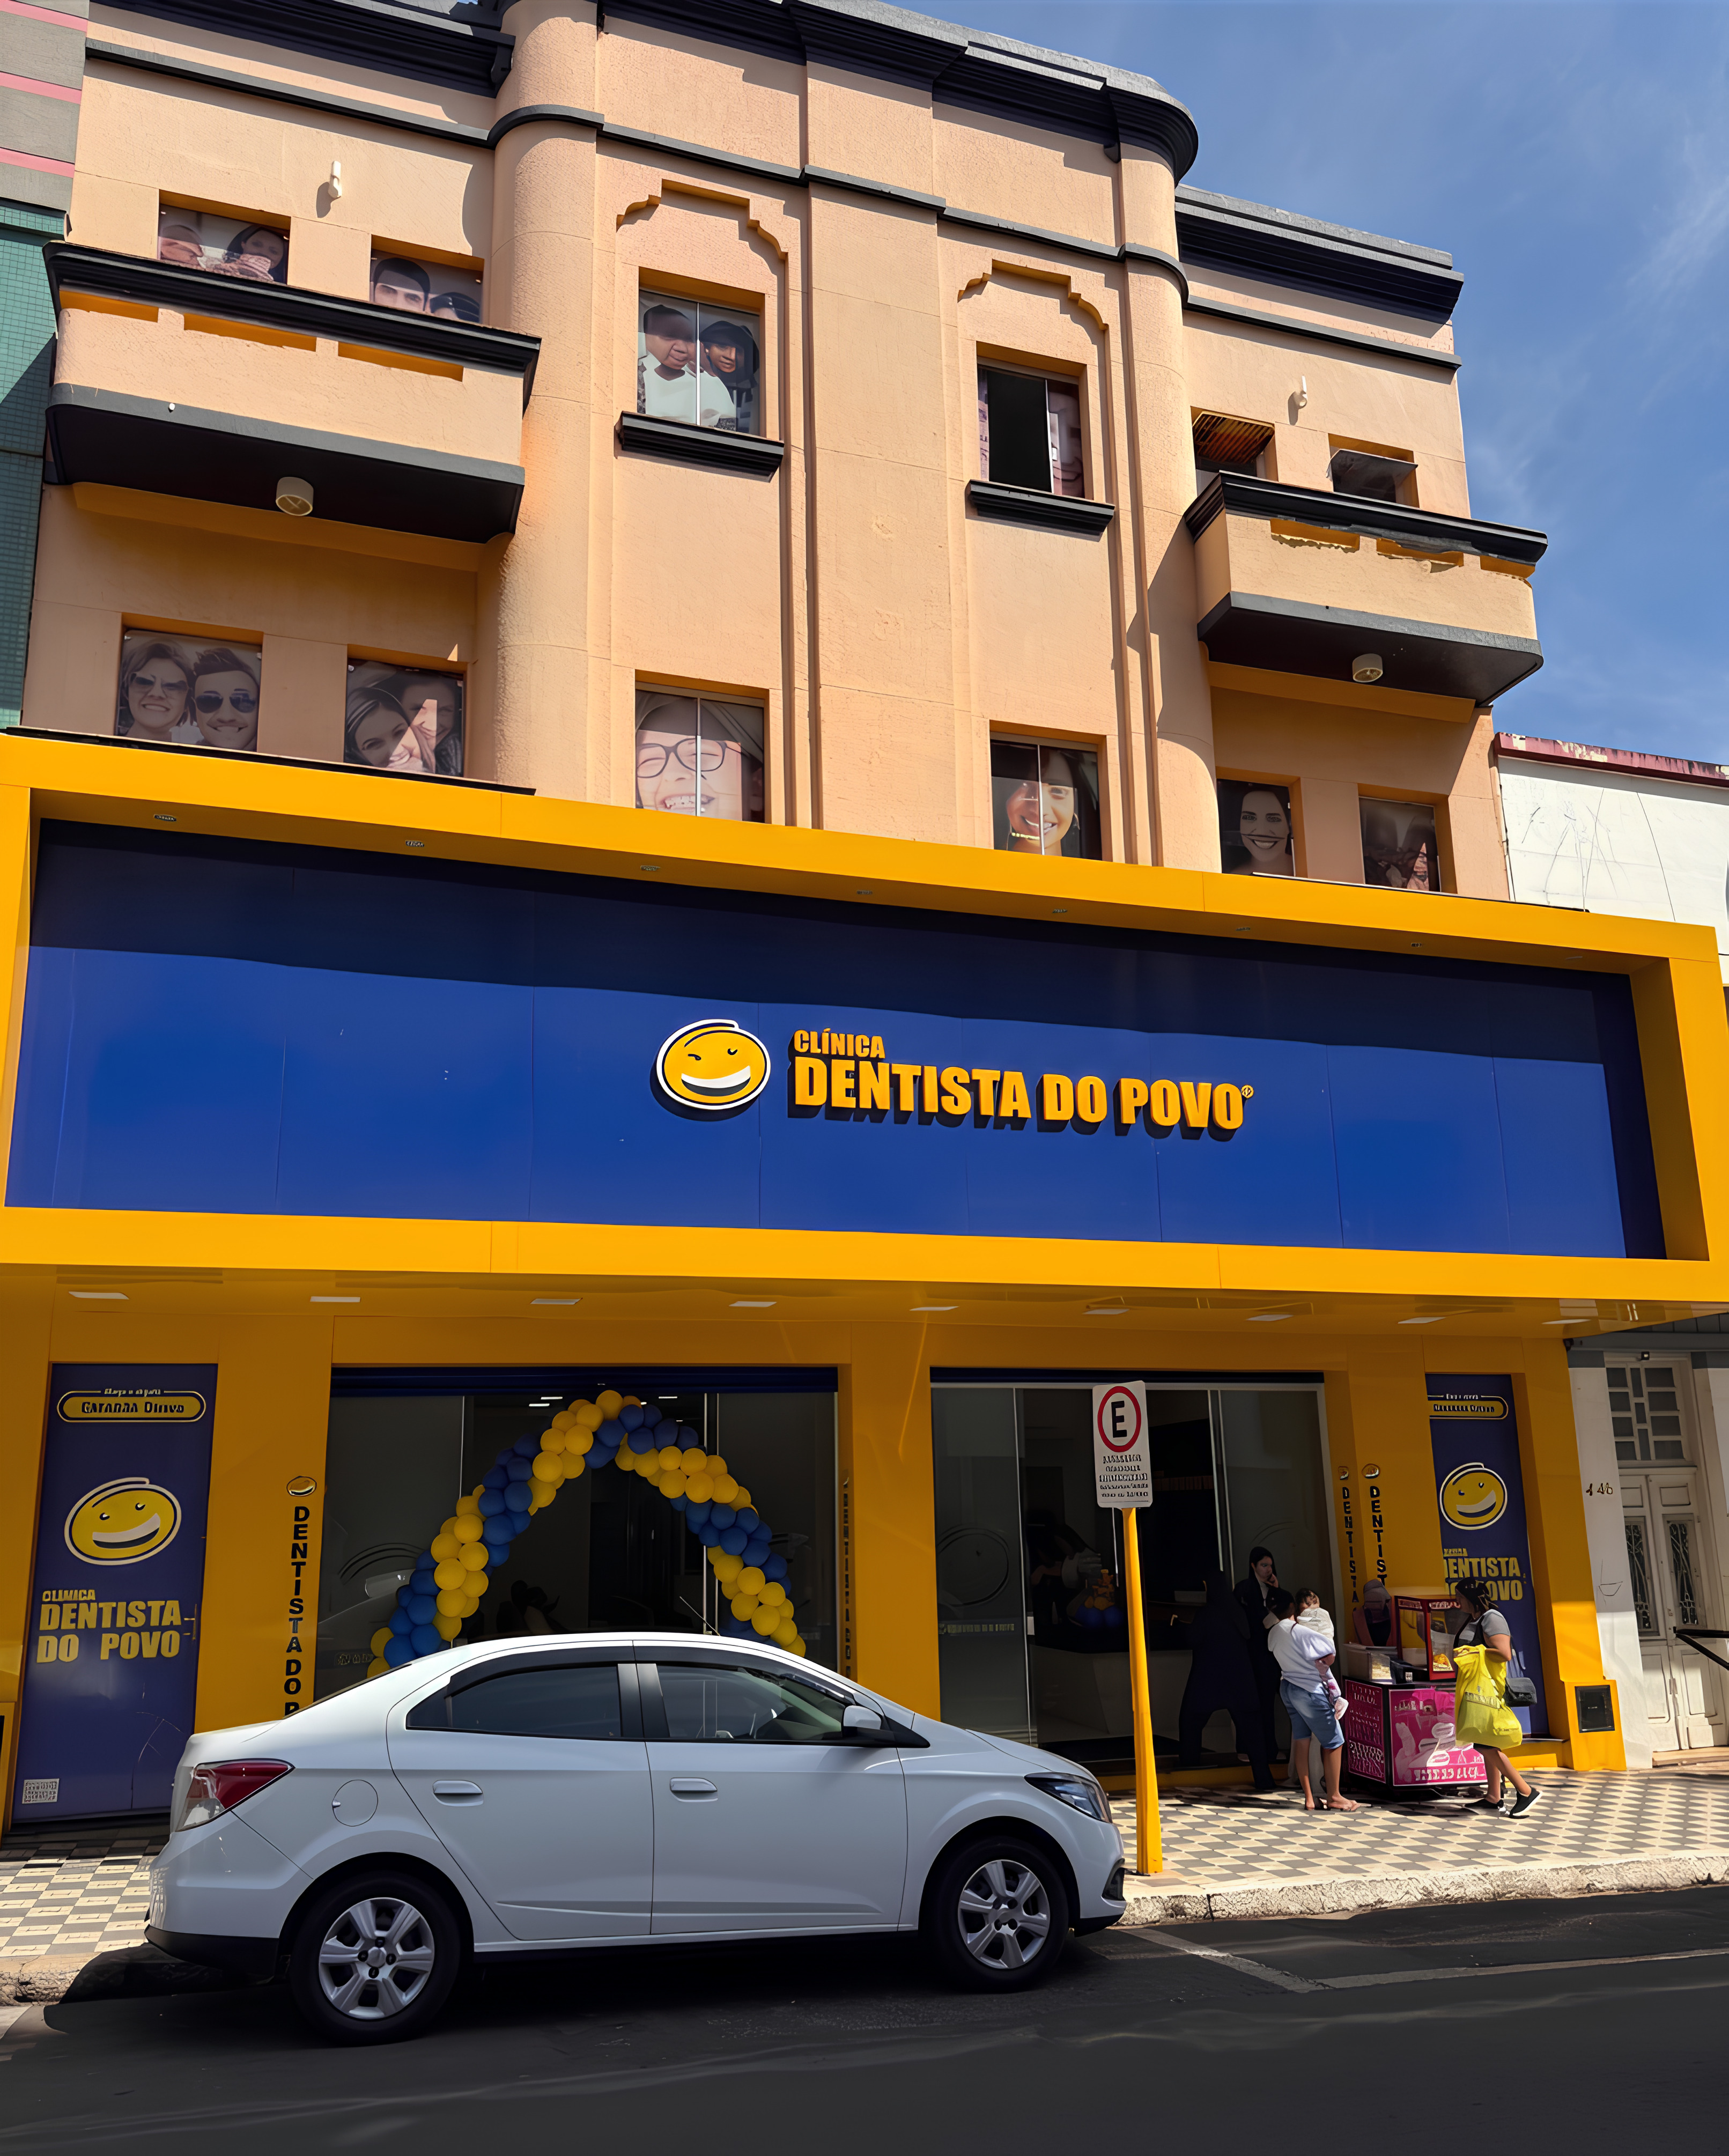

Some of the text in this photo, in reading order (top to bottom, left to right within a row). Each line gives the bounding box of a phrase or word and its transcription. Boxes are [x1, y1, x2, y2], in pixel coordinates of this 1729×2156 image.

[794, 1028, 885, 1059] CLÍNICA
[795, 1056, 1032, 1118] DENTISTA
[1043, 1074, 1108, 1123] DO
[1111, 1400, 1127, 1438] E
[1370, 1486, 1387, 1586] DENTIST
[286, 1506, 310, 1653] DENTISTA
[1475, 1579, 1523, 1601] OVO
[39, 1600, 182, 1630] DENTISTA
[36, 1630, 180, 1663] DO POVO
[284, 1659, 301, 1695] DO
